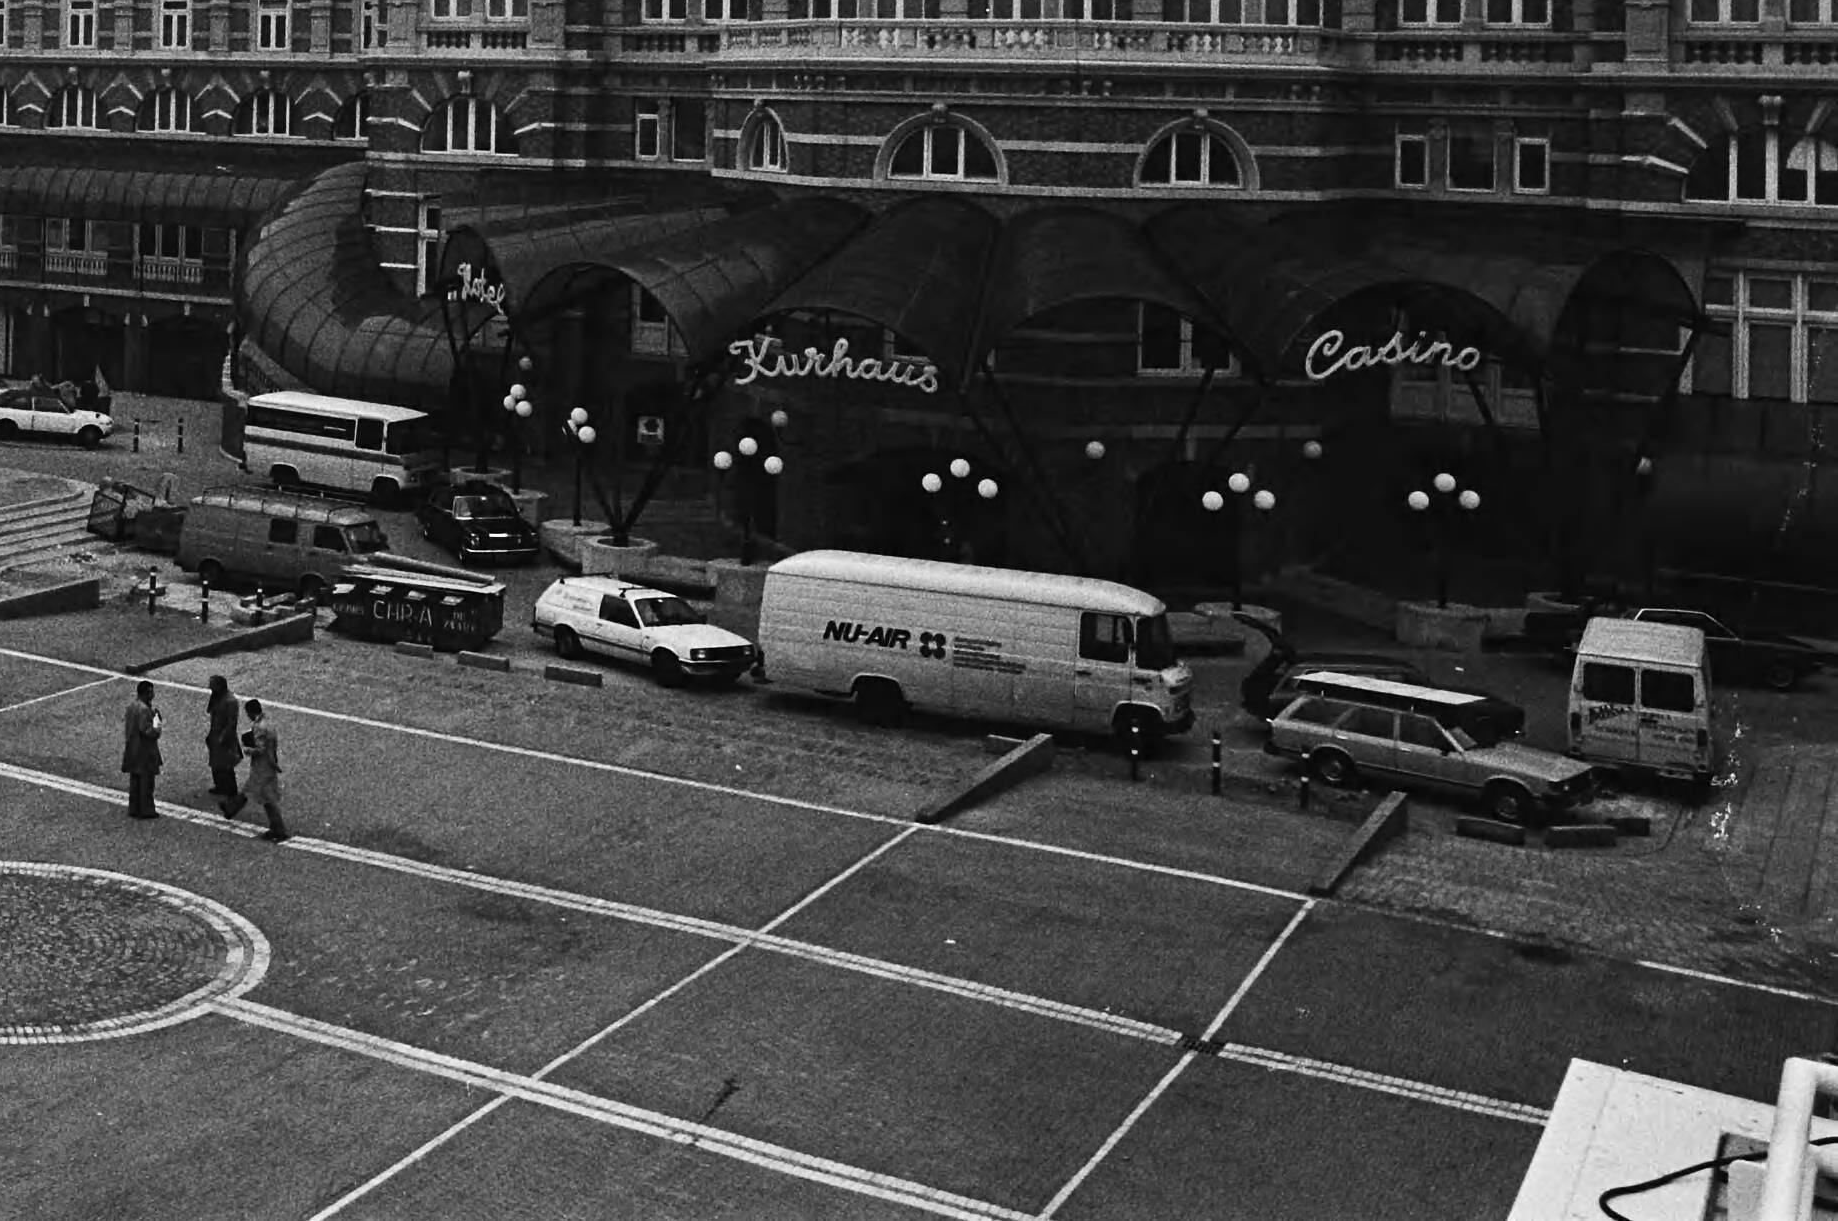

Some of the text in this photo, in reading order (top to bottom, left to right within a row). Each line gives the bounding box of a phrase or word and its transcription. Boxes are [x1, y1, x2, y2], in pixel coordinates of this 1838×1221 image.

[729, 337, 938, 393] Kurhaus
[1305, 330, 1480, 379] Casino
[823, 620, 911, 649] NU-AIR
